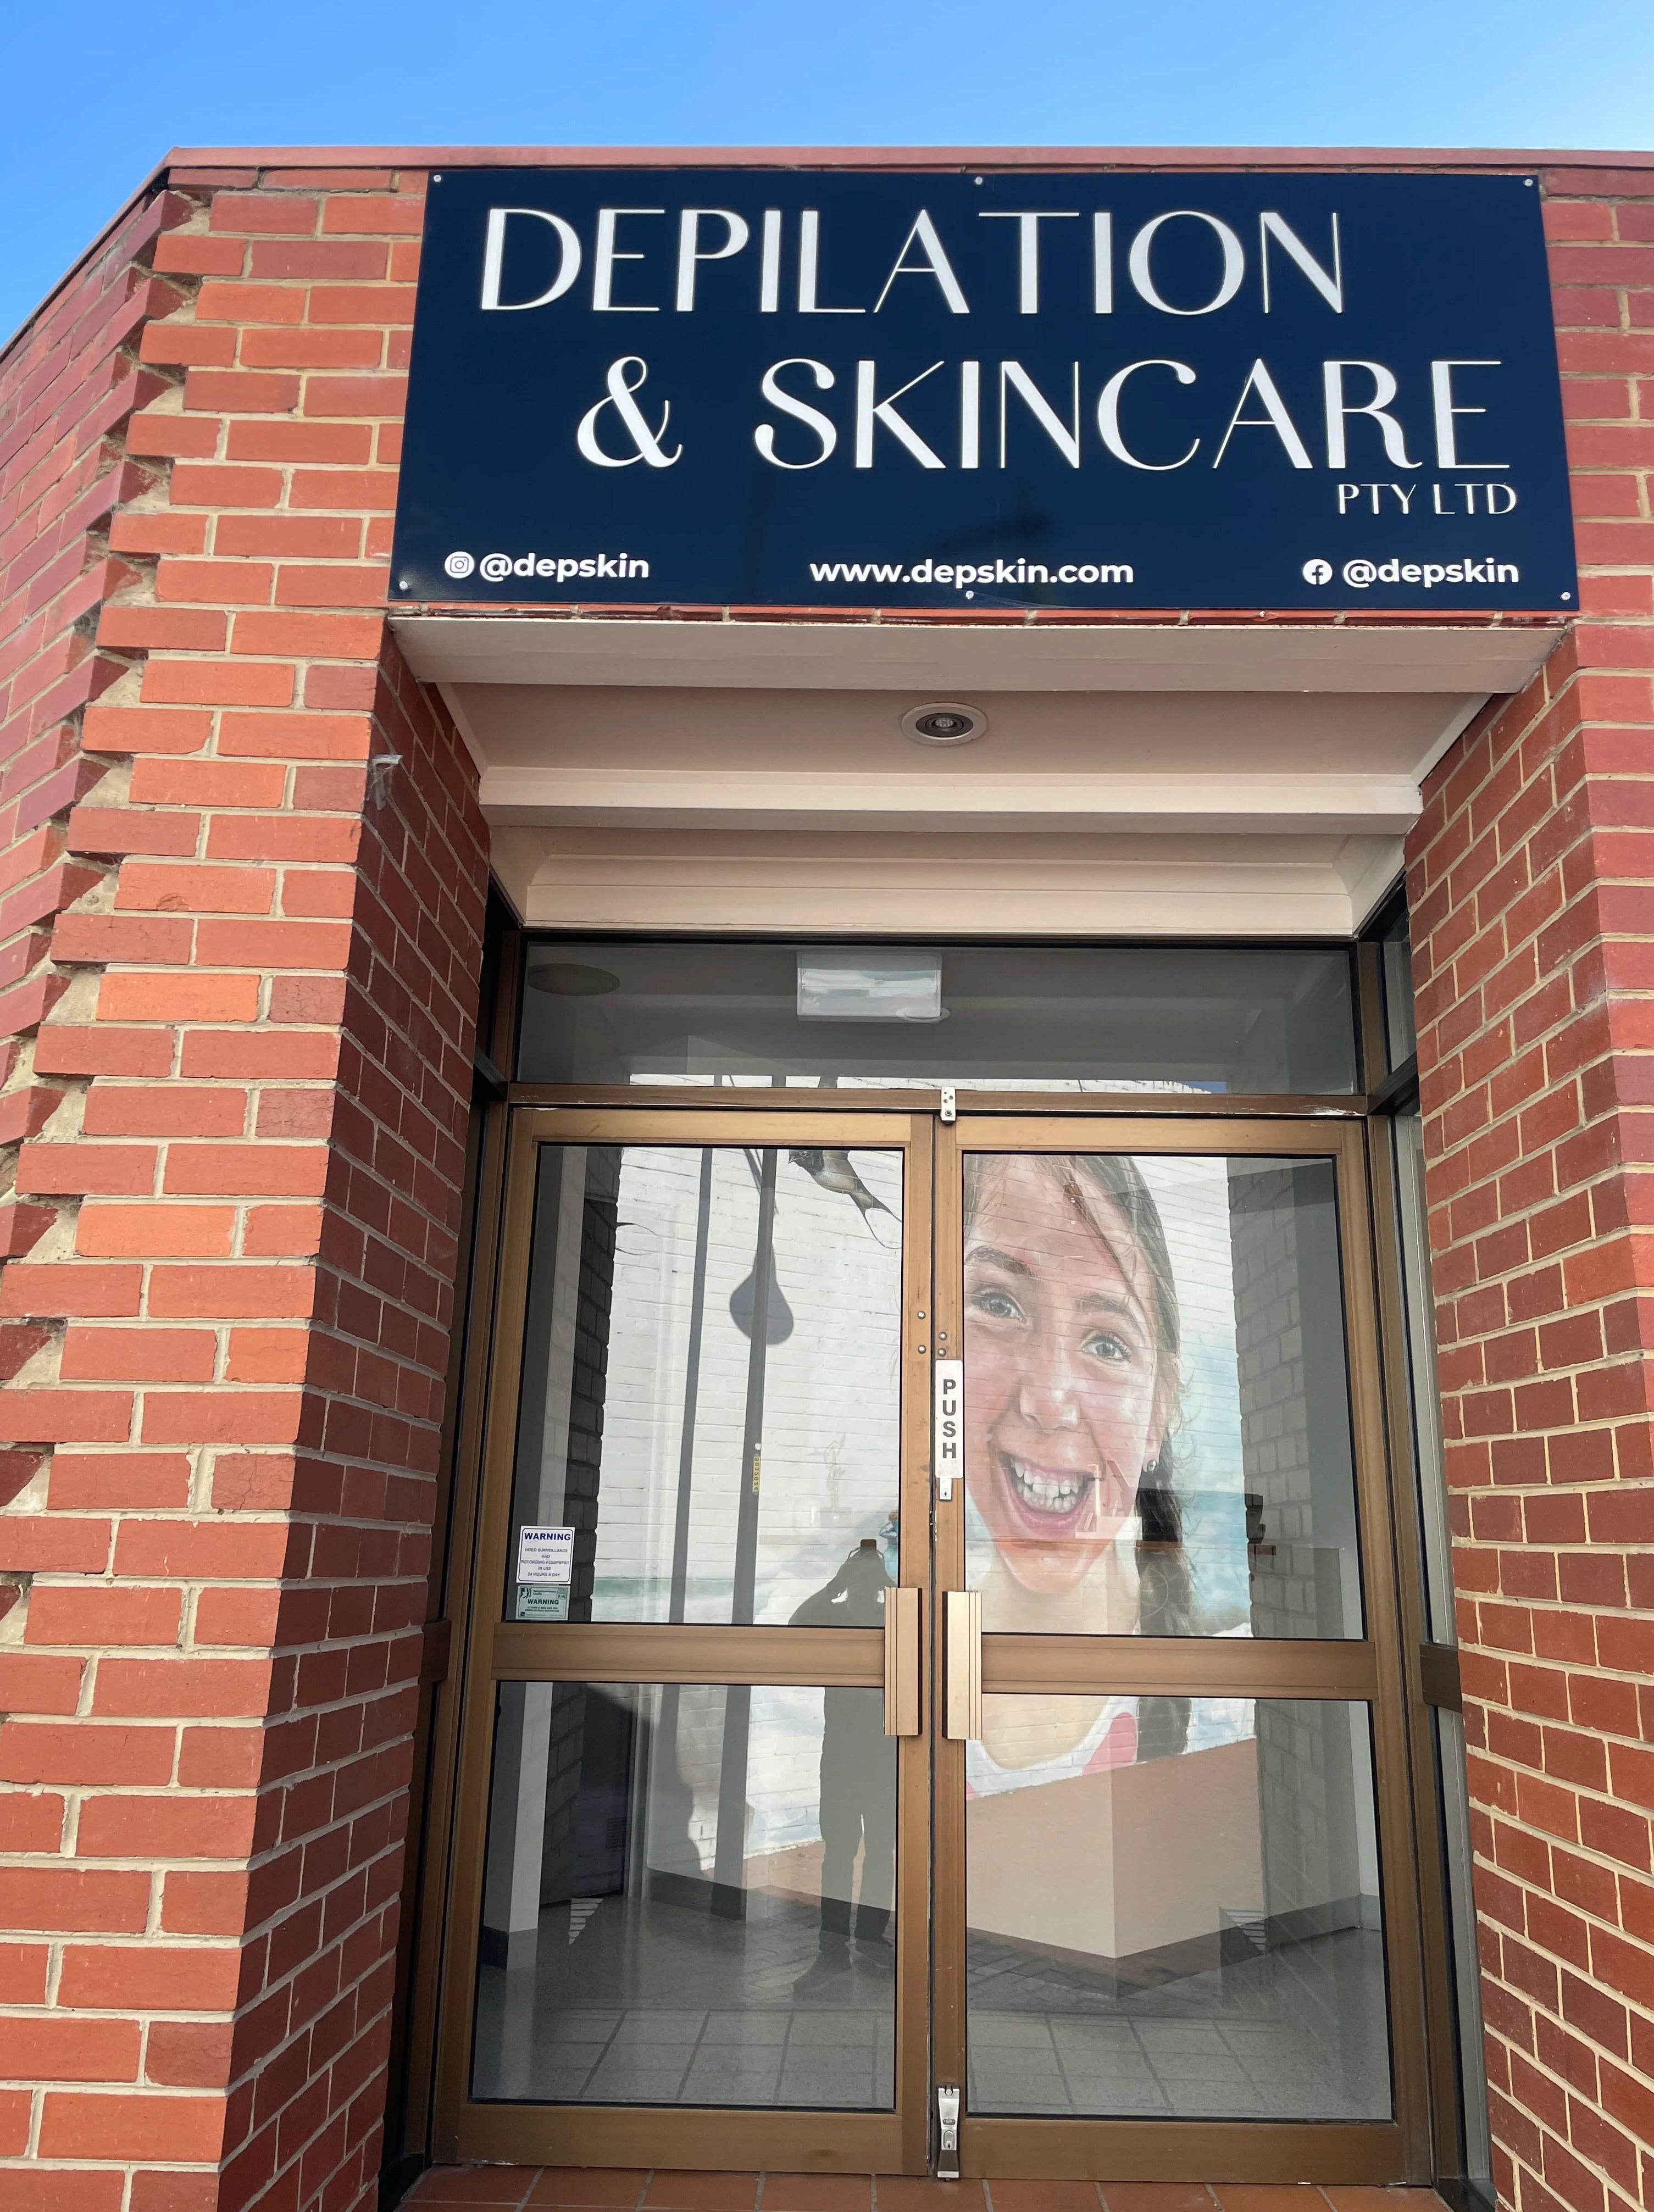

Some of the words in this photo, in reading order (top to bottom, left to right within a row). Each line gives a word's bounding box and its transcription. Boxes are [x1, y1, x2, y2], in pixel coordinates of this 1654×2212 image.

[481, 208, 1342, 315] DEPILATION
[577, 356, 682, 468] &
[754, 358, 1510, 470] SKINCARE
[1339, 483, 1417, 515] PTY
[1433, 483, 1517, 515] LTD
[480, 552, 649, 582] @depskin
[809, 558, 1134, 587] www.depskin.com
[1342, 557, 1519, 587] @depskin
[942, 1379, 956, 1459] PUSH
[524, 1532, 571, 1541] WARNING
